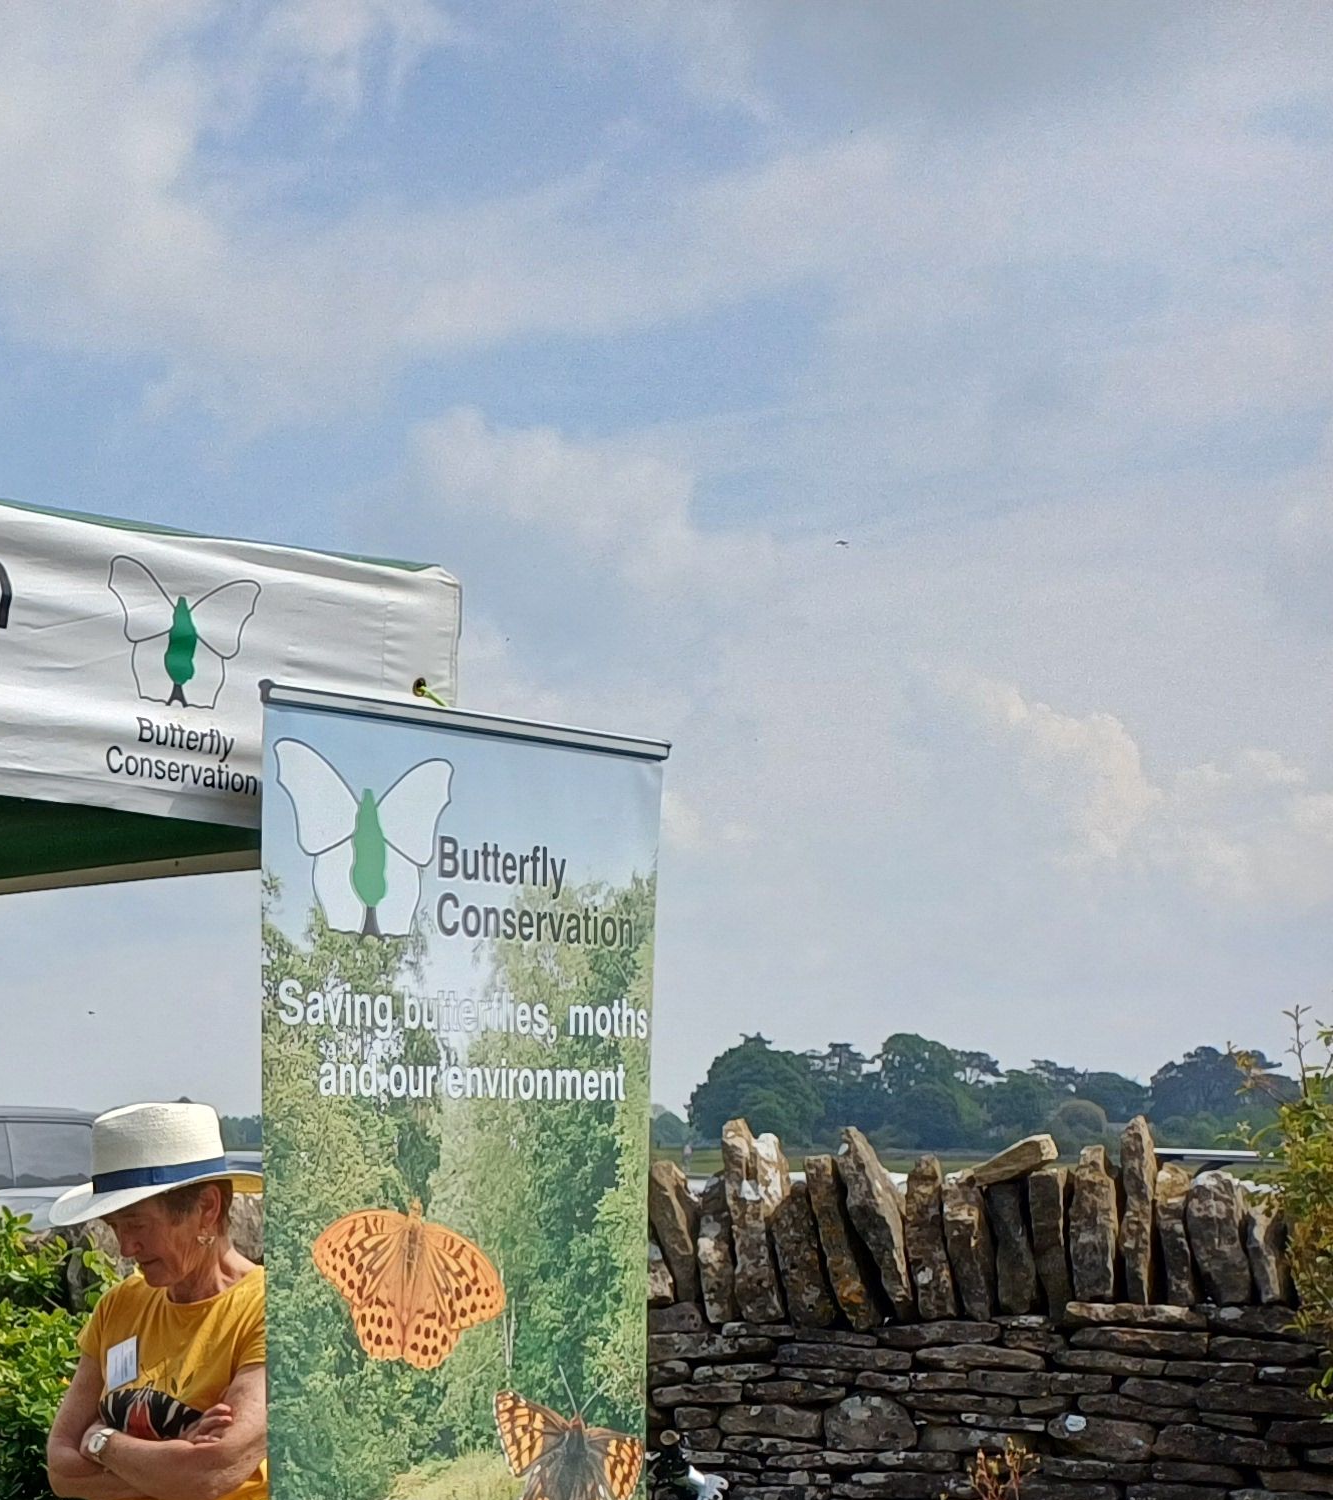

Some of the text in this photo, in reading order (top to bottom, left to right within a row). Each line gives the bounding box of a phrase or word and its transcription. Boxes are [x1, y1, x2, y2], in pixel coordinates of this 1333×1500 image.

[136, 716, 234, 762] Butterfly
[106, 746, 258, 796] Conservation
[437, 835, 566, 899] Butterfly
[436, 893, 634, 948] Conservation
[277, 978, 649, 1043] Saving butterflies, moths
[319, 1059, 626, 1101] and our environment
